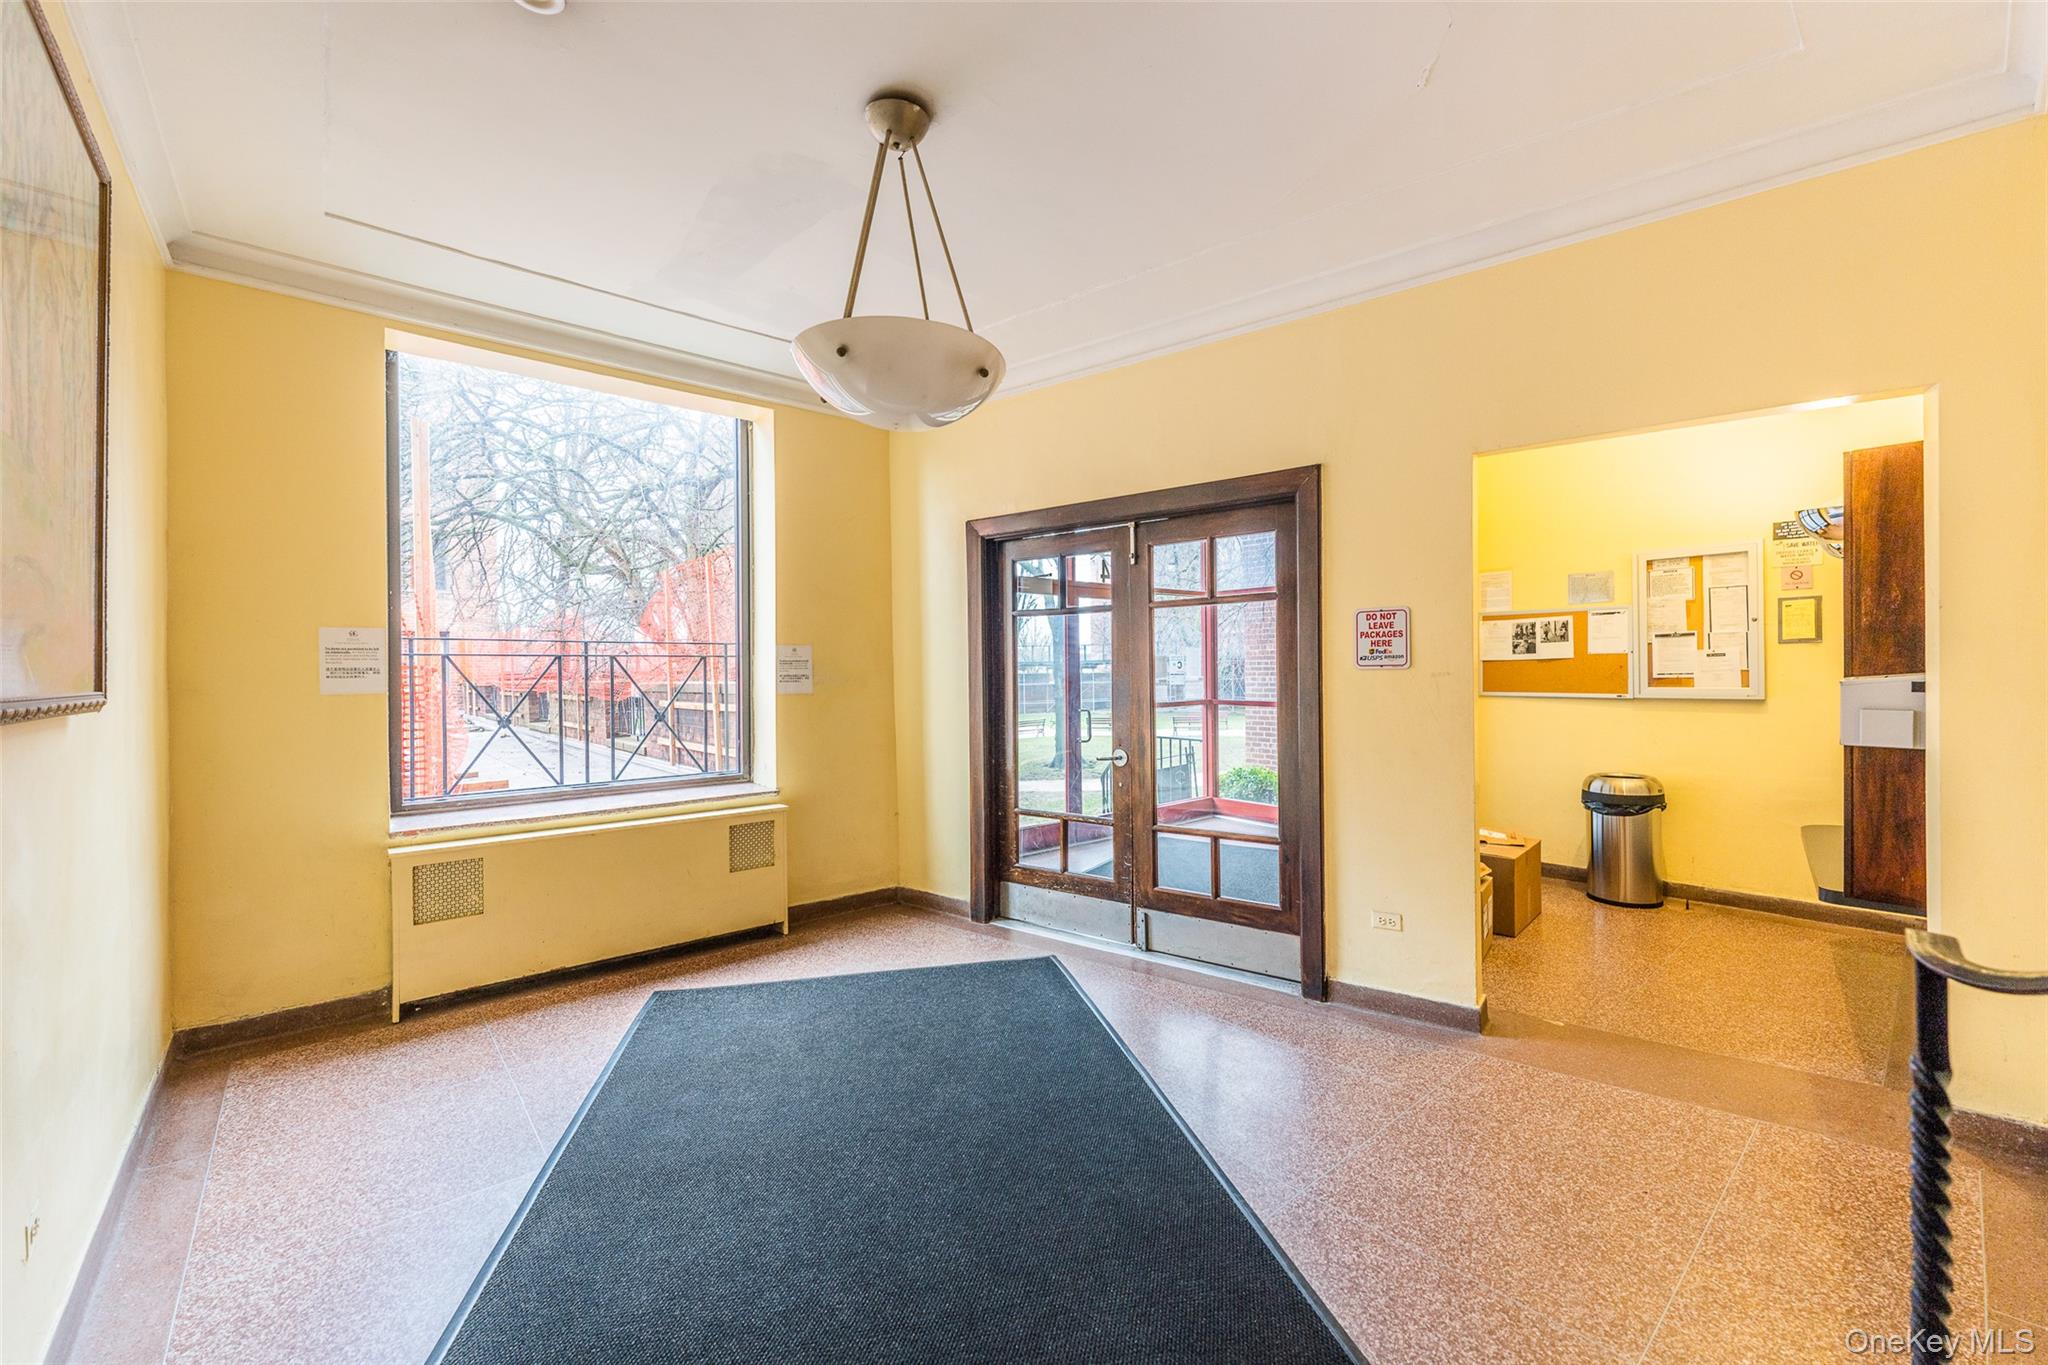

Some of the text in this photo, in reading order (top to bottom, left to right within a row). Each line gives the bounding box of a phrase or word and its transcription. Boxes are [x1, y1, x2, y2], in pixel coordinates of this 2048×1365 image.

[1366, 612, 1397, 621] DO NOT
[1369, 621, 1394, 630] LEAVE
[1360, 630, 1404, 639] PACKAGES
